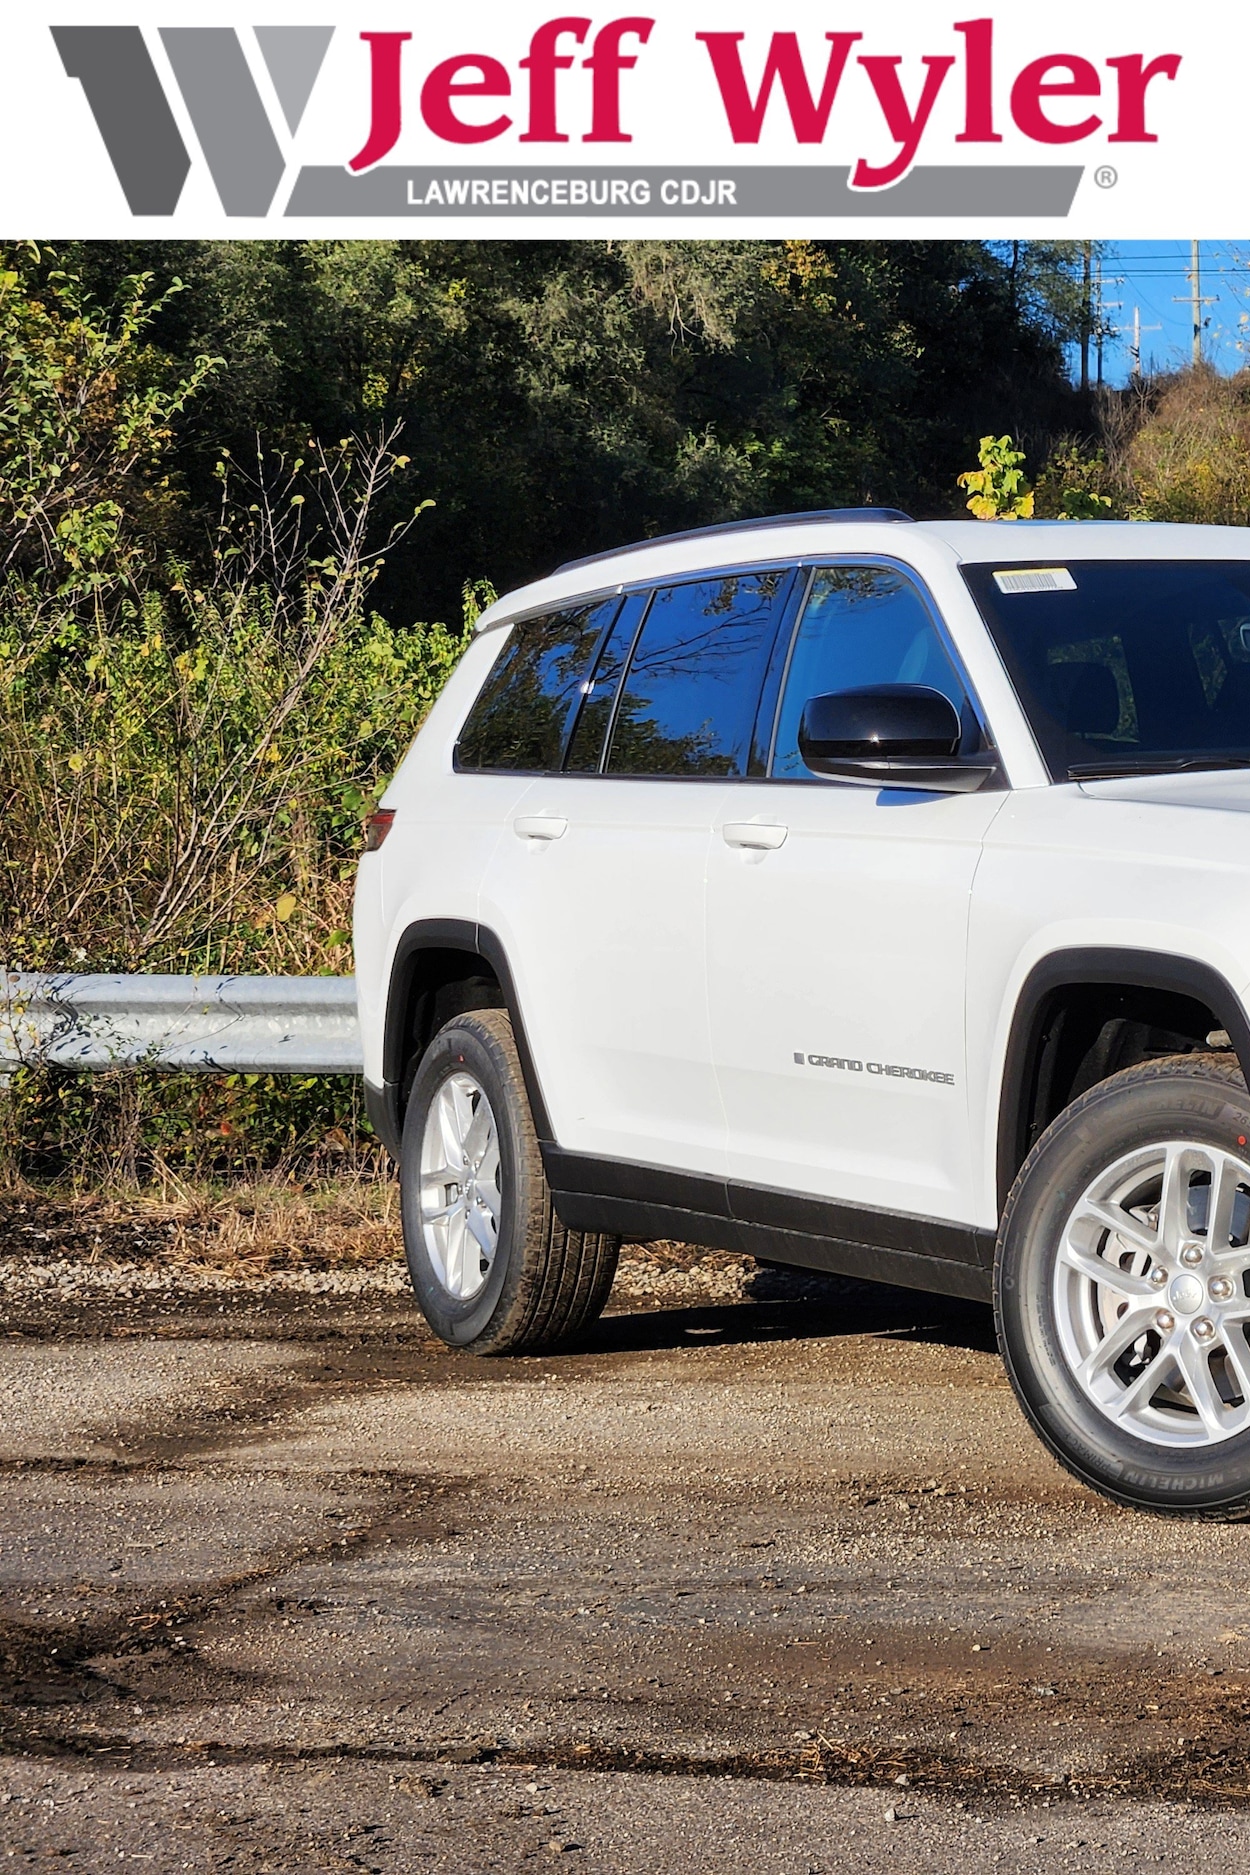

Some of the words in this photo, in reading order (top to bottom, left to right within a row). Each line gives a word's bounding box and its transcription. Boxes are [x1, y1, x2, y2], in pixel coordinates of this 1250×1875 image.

[807, 1054, 864, 1072] GRAND
[866, 1062, 955, 1086] CHEROKEE
[1123, 1471, 1224, 1491] MICHELIN
